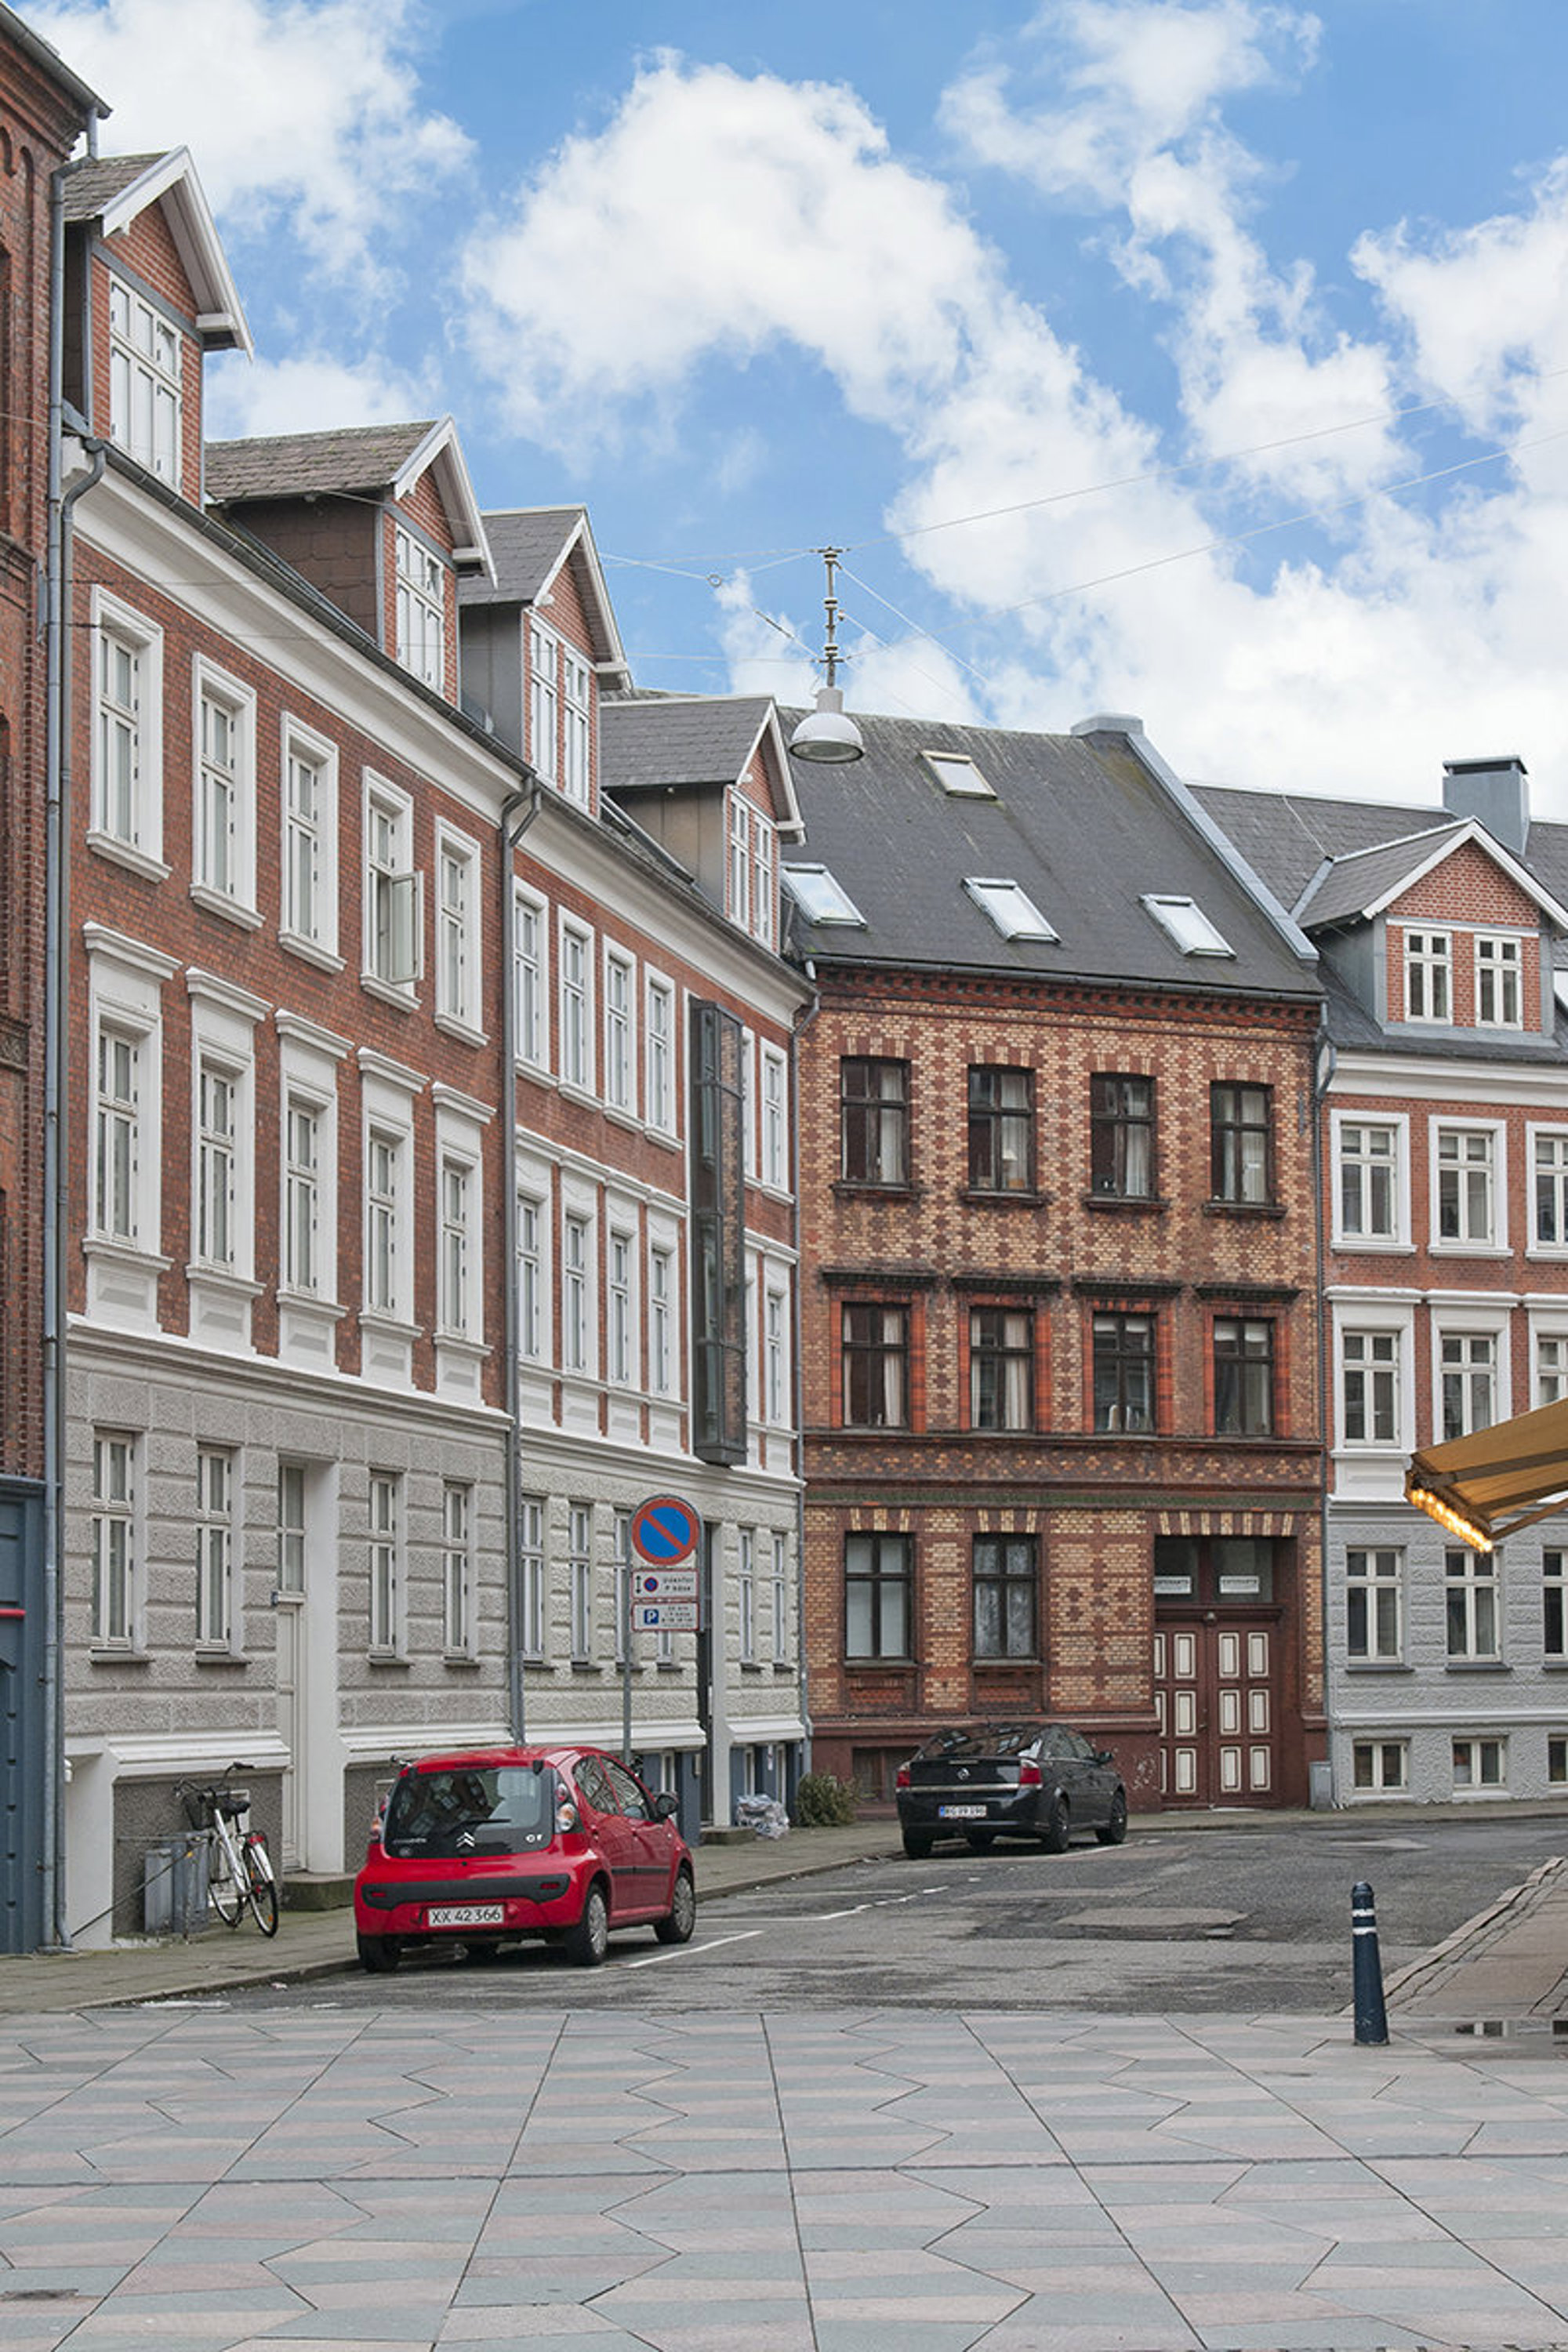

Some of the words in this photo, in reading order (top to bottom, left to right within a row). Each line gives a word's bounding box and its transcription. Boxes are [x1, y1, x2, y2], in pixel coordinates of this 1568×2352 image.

[646, 1610, 657, 1624] P
[432, 1911, 452, 1923] XX
[455, 1909, 471, 1922] 42
[474, 1907, 501, 1922] 366
